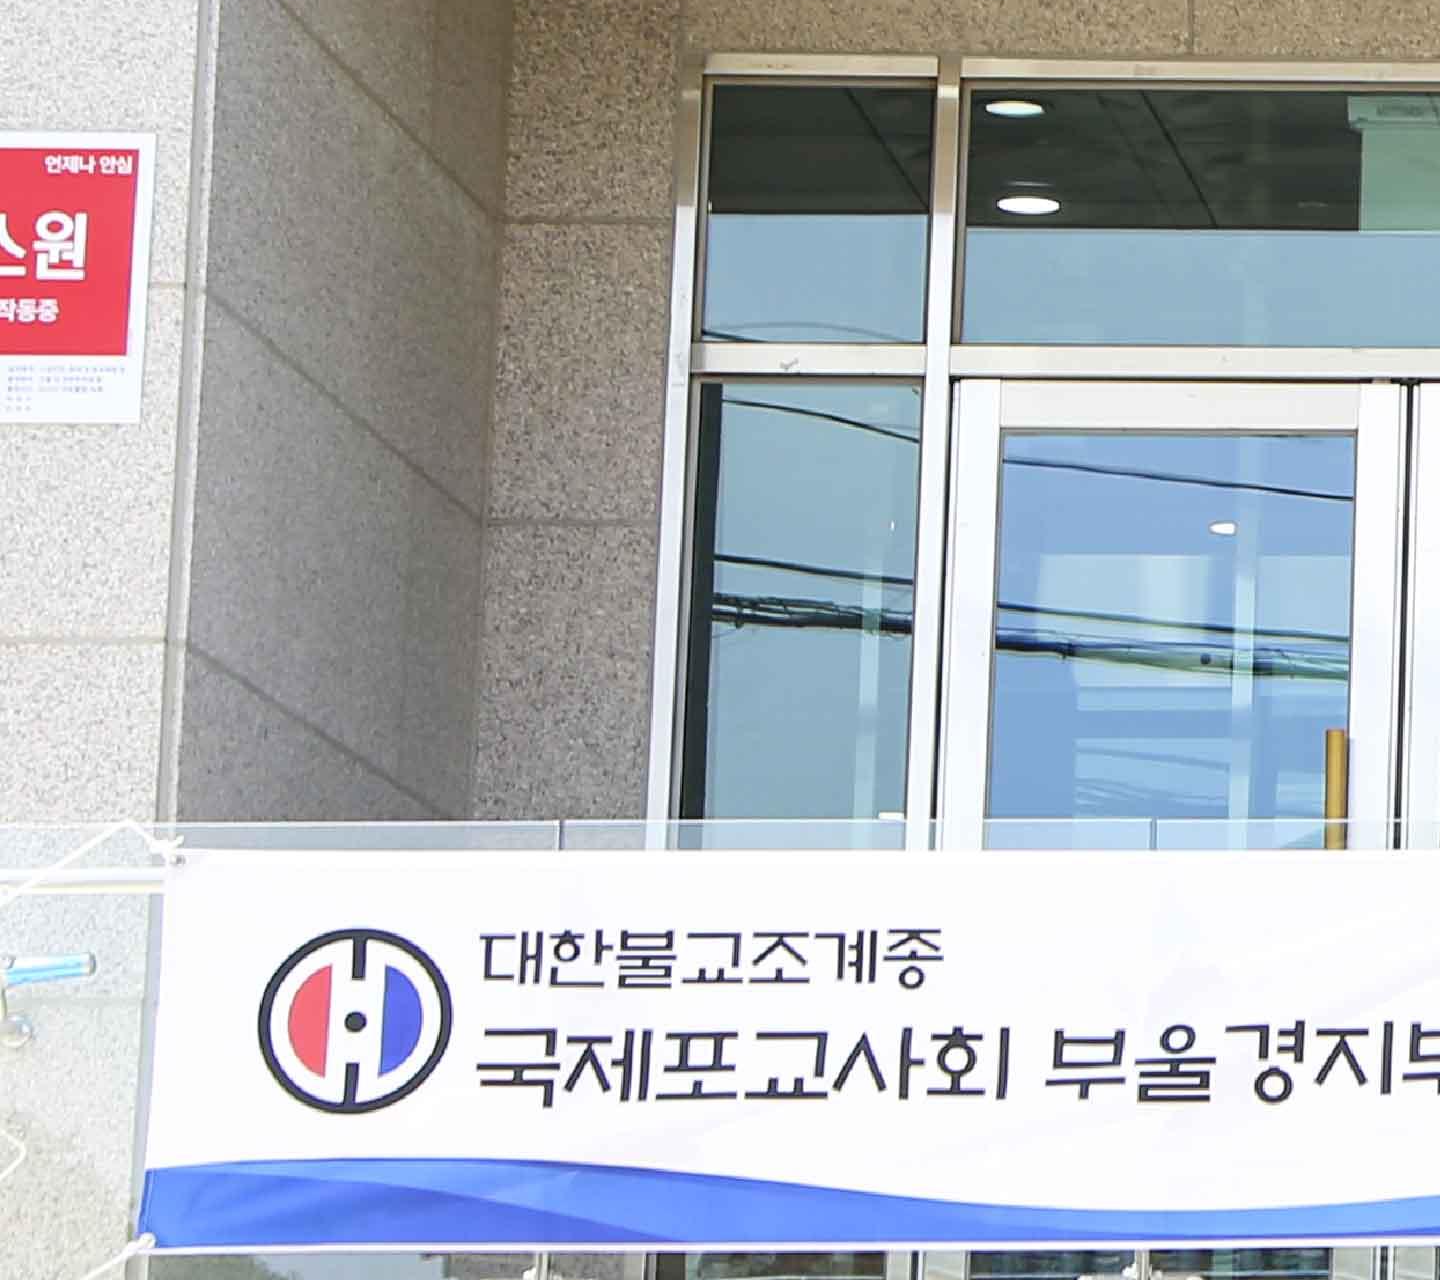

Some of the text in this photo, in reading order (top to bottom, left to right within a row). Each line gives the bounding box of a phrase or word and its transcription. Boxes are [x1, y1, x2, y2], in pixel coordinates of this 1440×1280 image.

[44, 155, 133, 175] 언제나 안심
[480, 930, 942, 989] 대한불교조계종
[477, 1027, 1009, 1107] 국제포교사회
